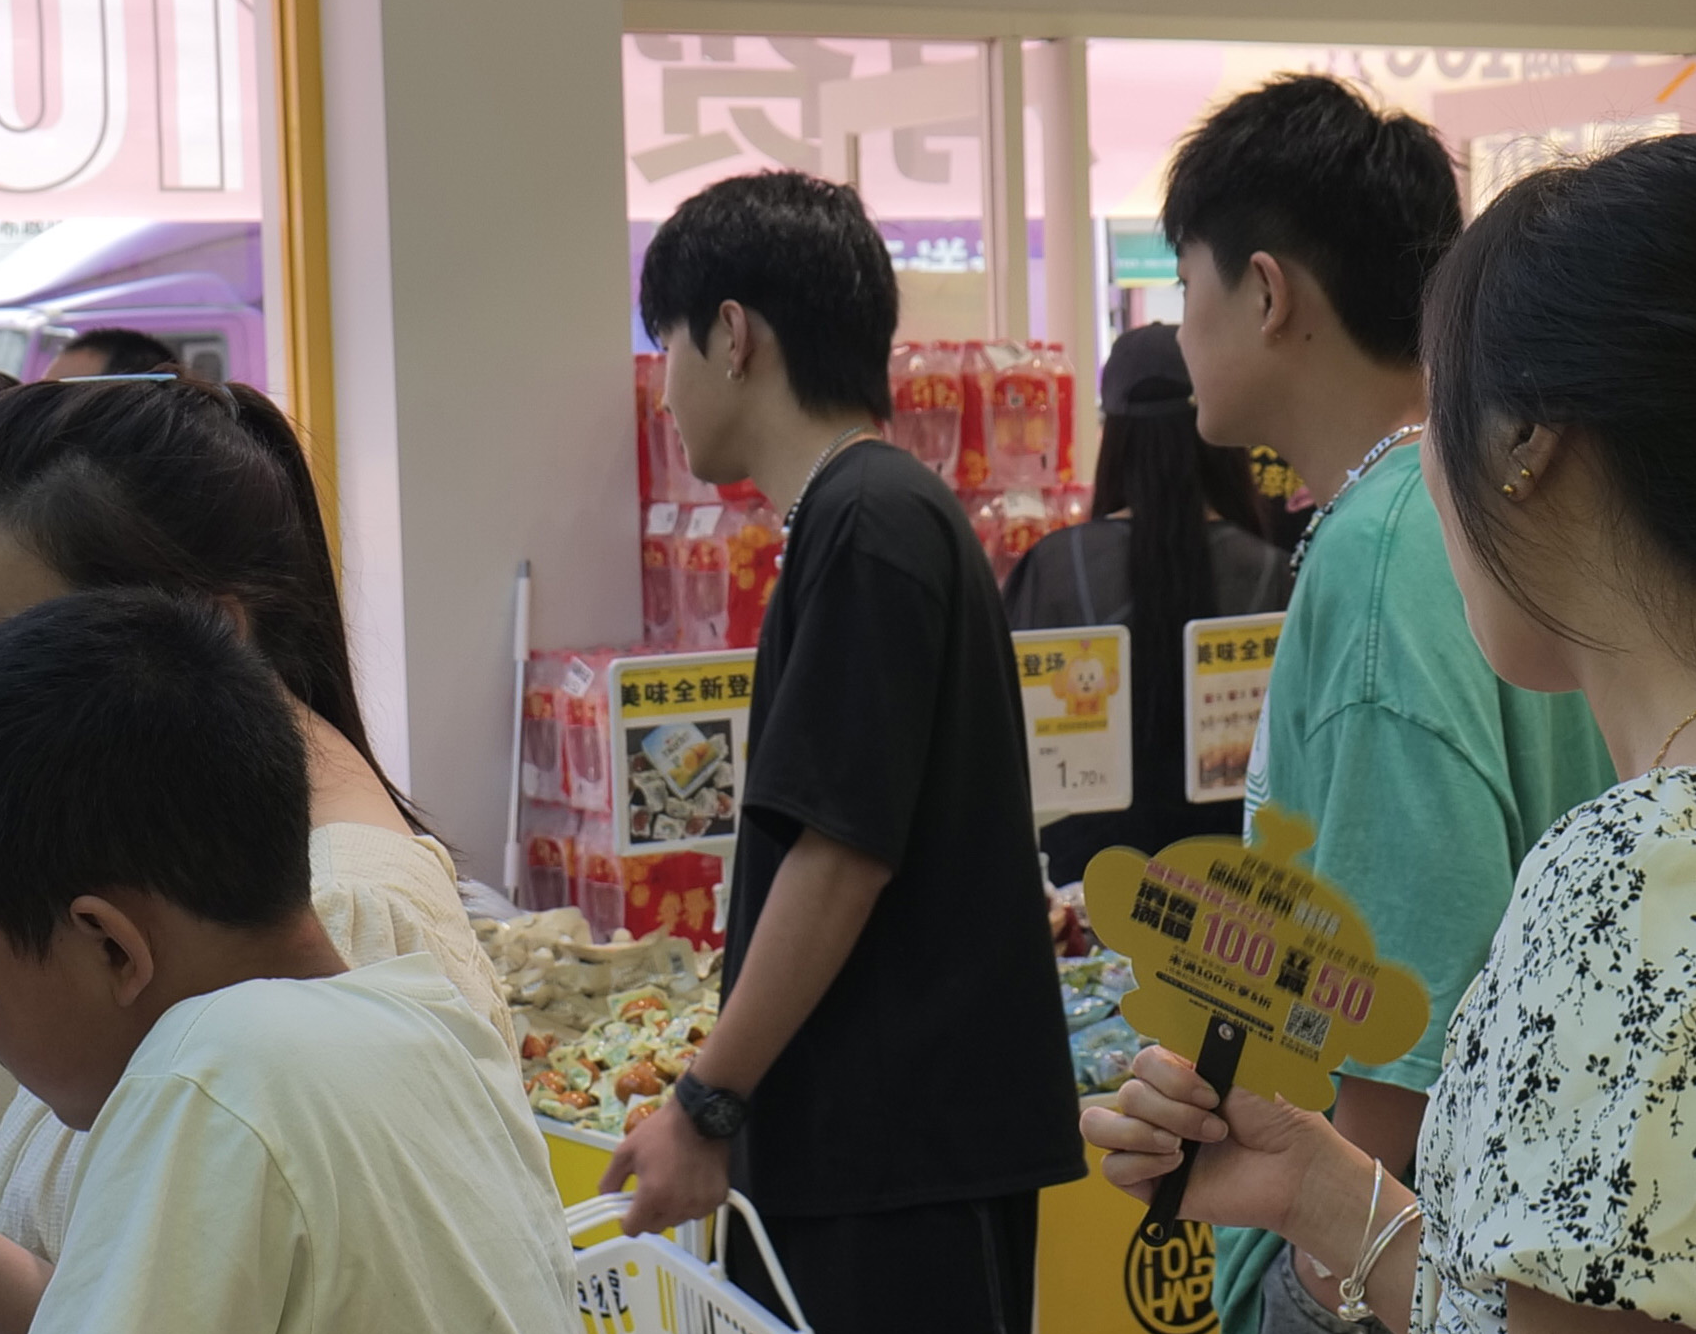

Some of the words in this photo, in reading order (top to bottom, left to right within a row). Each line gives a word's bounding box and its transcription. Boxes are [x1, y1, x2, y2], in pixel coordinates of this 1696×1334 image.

[1015, 651, 1067, 678] 登场
[1201, 912, 1278, 980] 100
[1309, 960, 1377, 1025] 50
